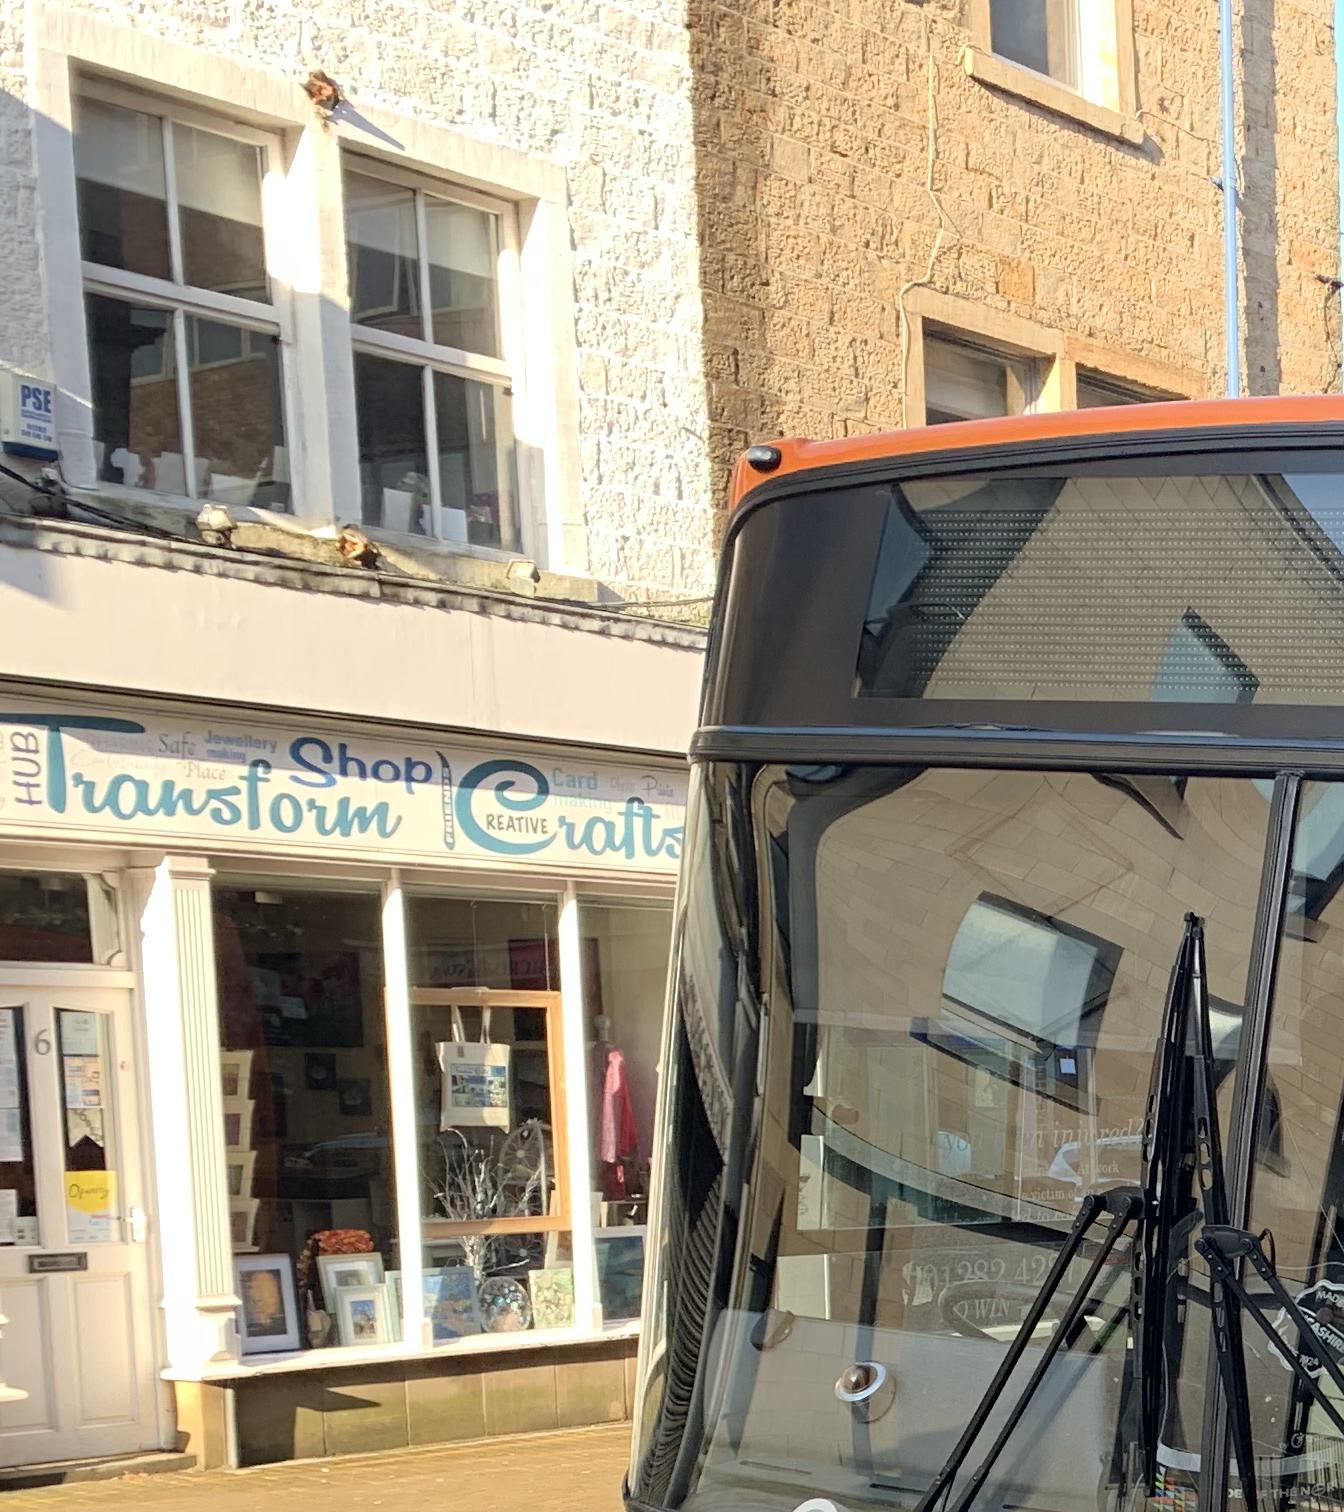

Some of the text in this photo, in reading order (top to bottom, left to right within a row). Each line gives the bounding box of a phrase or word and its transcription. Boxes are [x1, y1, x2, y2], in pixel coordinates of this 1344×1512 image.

[21, 384, 51, 413] PSE
[158, 731, 197, 766] Safe
[204, 731, 278, 753] Jewellery
[0, 713, 403, 840] Transform
[186, 762, 226, 781] Place
[289, 737, 433, 794] Shop
[552, 768, 598, 790] Card
[552, 794, 612, 814] making
[34, 1029, 51, 1055] 6
[1315, 1290, 1344, 1307] MADE
